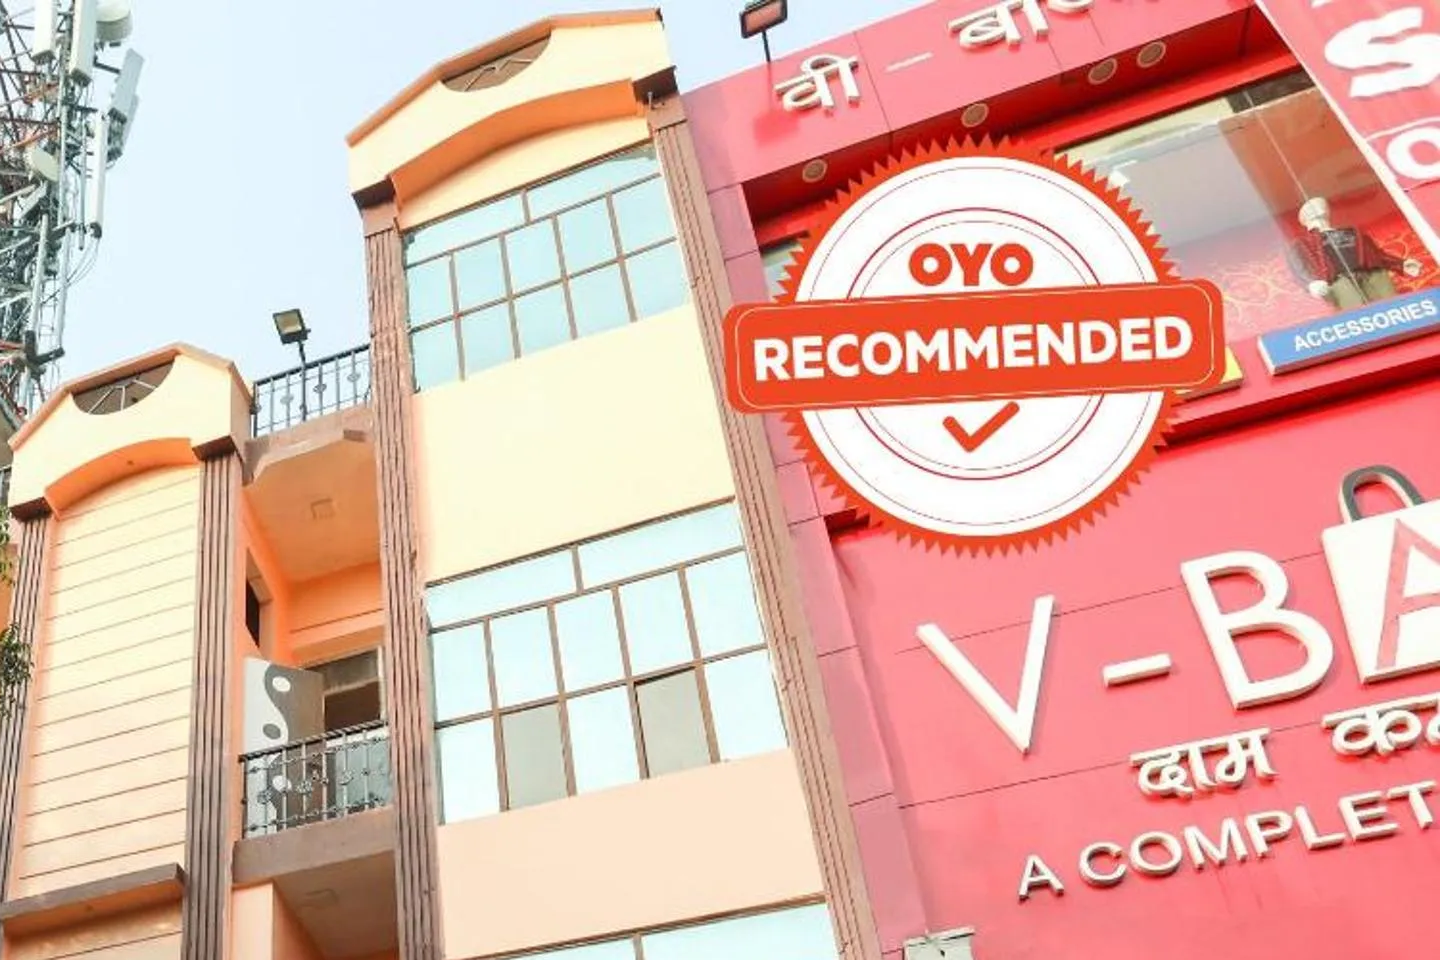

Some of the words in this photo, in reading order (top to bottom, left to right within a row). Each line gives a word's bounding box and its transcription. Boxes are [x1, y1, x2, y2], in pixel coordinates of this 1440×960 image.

[1292, 297, 1438, 353] ACCESSORIES
[1130, 727, 1278, 799] दाम
[1017, 852, 1066, 902] A
